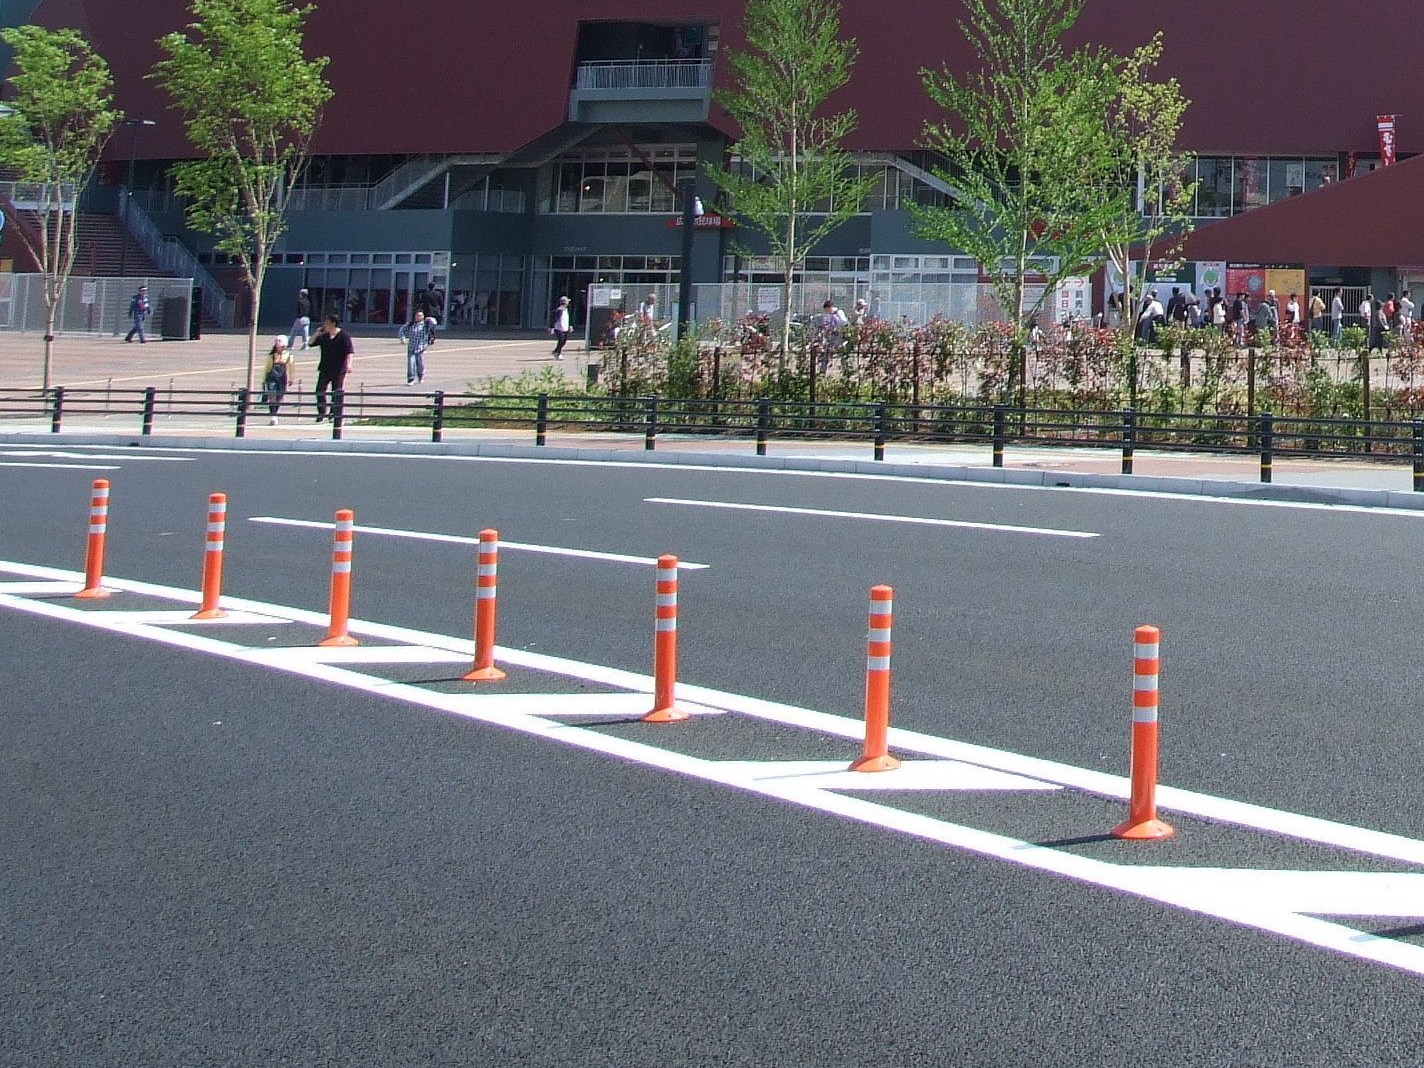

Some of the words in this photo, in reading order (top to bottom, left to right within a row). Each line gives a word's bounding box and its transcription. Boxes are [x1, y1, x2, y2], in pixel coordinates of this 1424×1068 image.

[676, 215, 721, 226] 広市民球場
